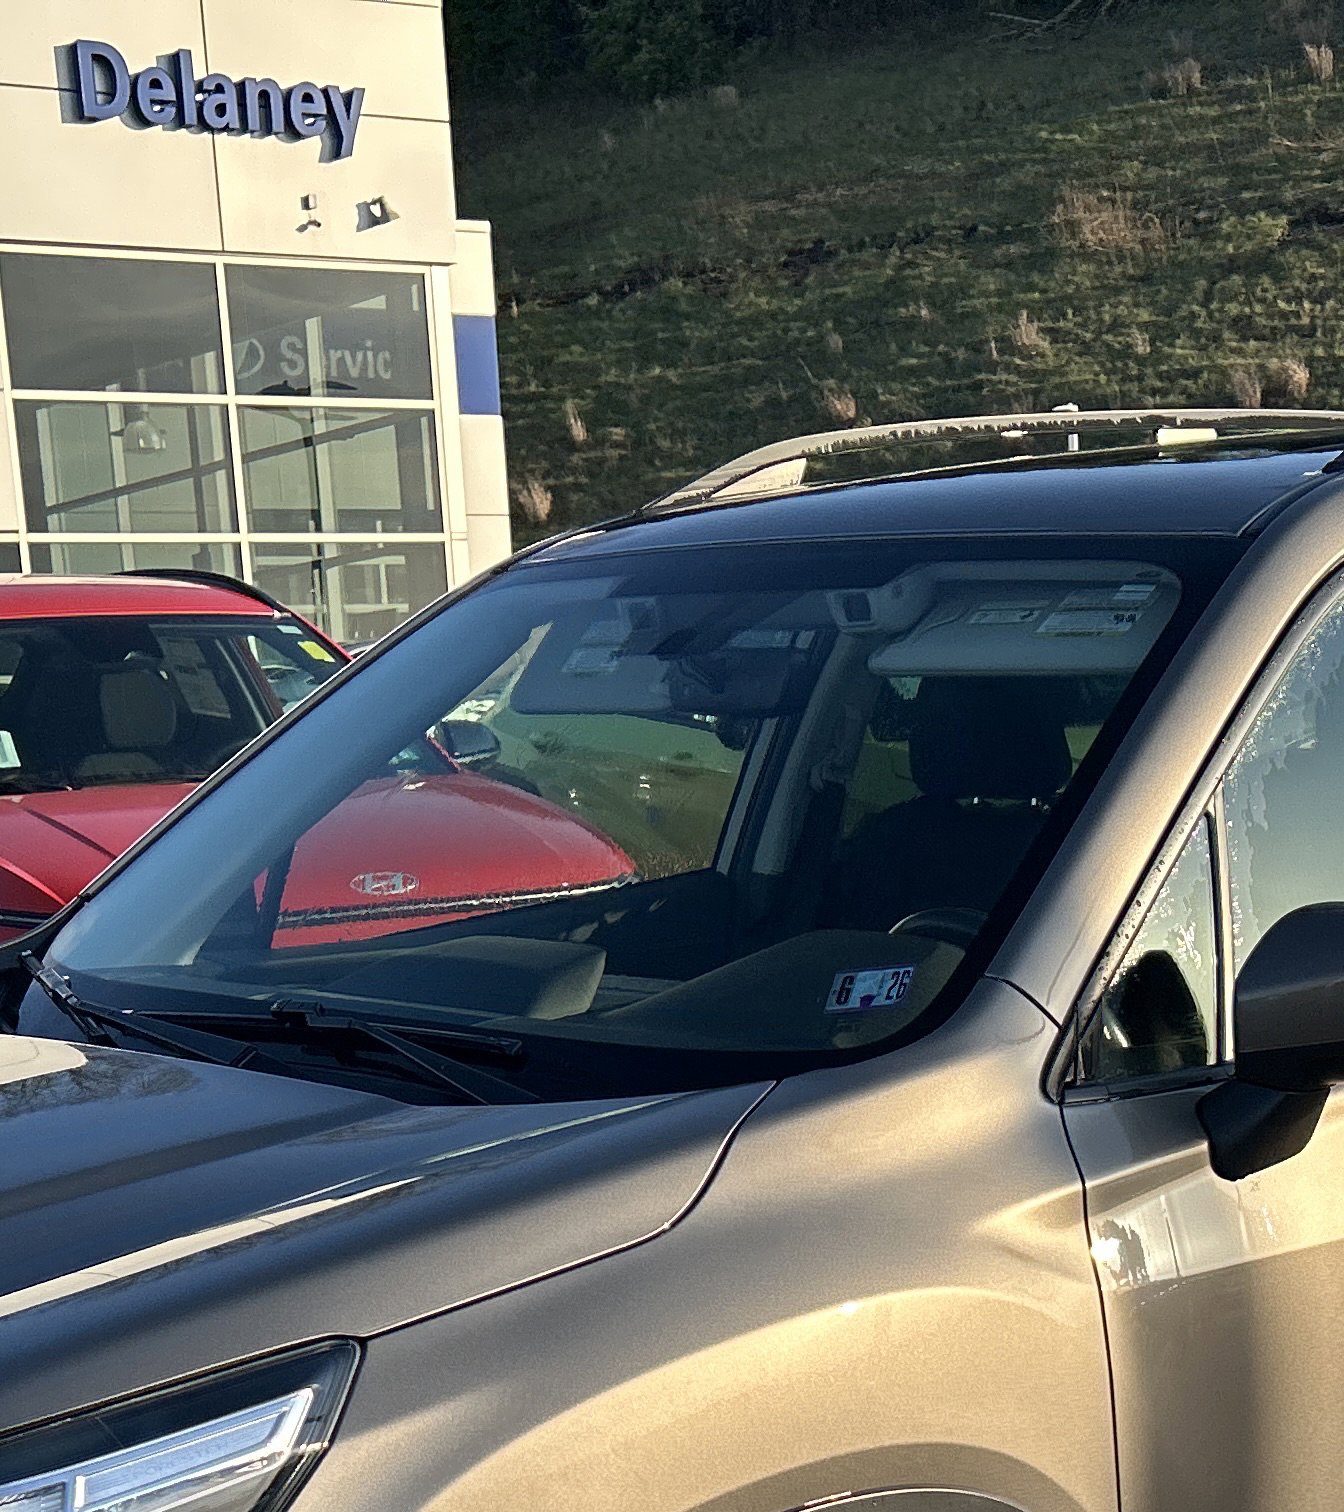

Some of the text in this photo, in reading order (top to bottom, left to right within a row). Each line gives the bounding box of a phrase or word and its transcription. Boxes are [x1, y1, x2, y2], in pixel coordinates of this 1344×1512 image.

[64, 39, 365, 163] Delaney
[280, 335, 392, 380] Srvic
[884, 969, 912, 1001] 26
